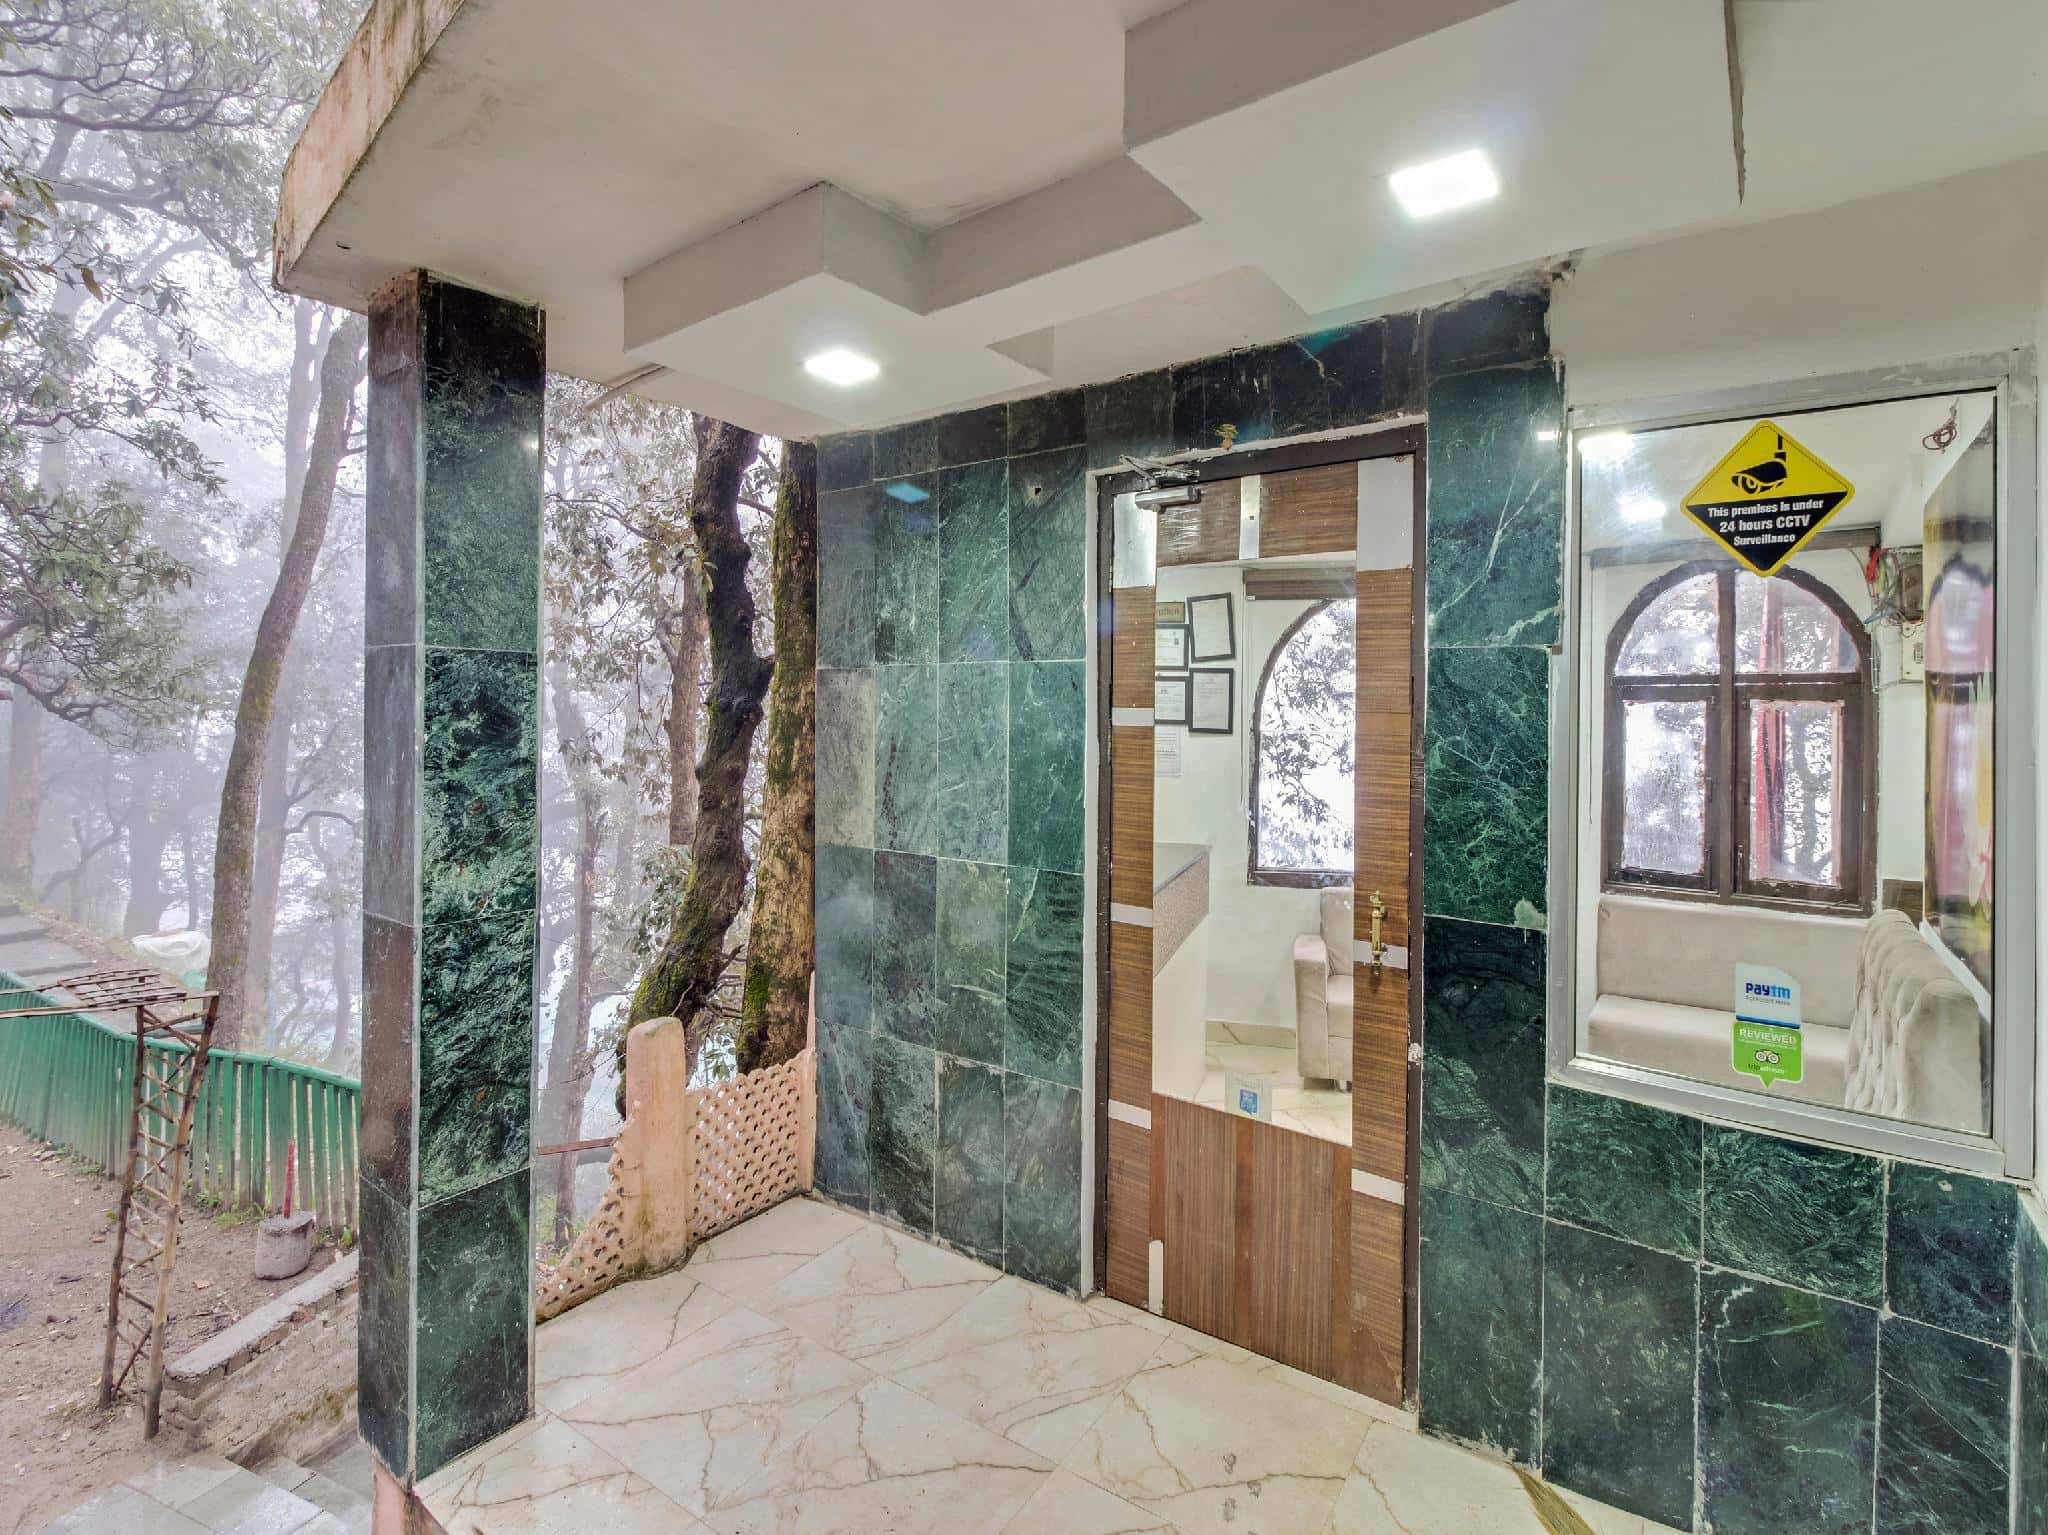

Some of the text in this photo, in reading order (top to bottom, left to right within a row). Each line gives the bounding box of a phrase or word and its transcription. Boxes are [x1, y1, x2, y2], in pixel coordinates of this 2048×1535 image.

[1708, 499, 1824, 518] This premises is under
[1719, 514, 1811, 533] 24 hours CCTV
[1733, 533, 1795, 546] Surveillance
